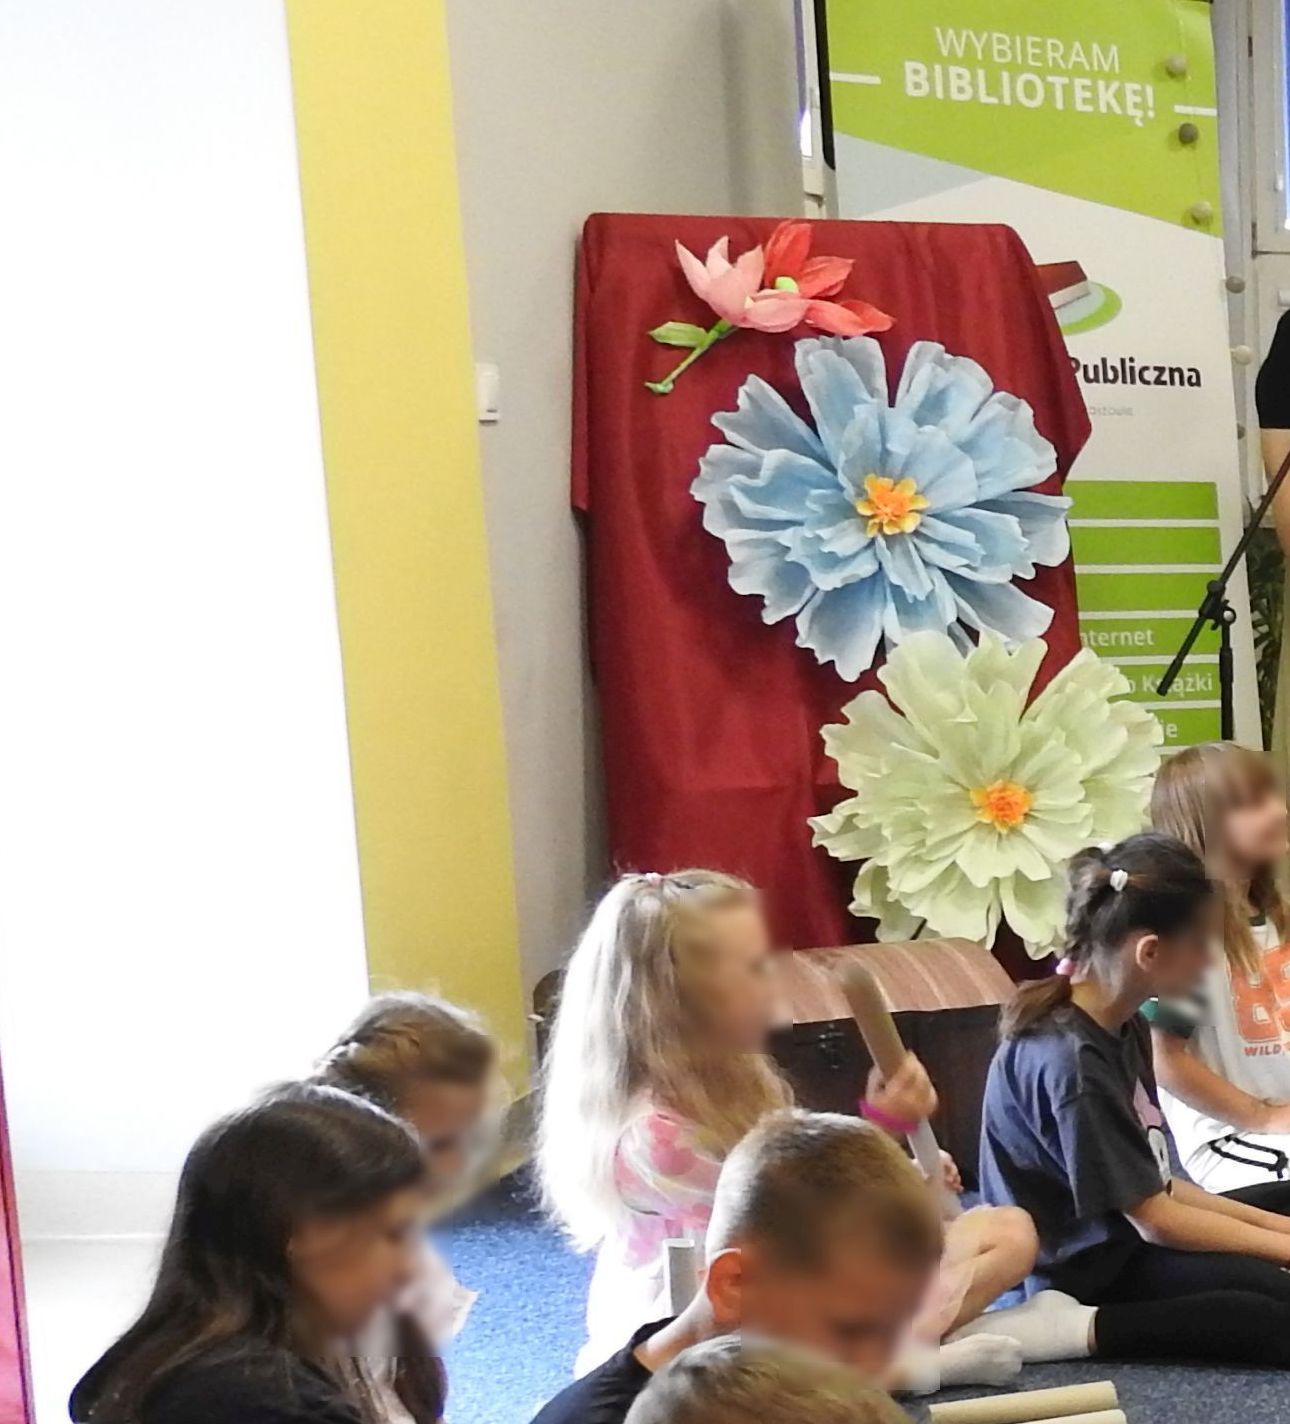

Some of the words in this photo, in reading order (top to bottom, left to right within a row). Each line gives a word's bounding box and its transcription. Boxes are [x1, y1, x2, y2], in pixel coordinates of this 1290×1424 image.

[934, 26, 1120, 74] WYBIERAM
[903, 60, 1156, 127] BIBLIOTEKĘ!
[1079, 629, 1155, 647] nternet
[1142, 672, 1213, 697] Kążki
